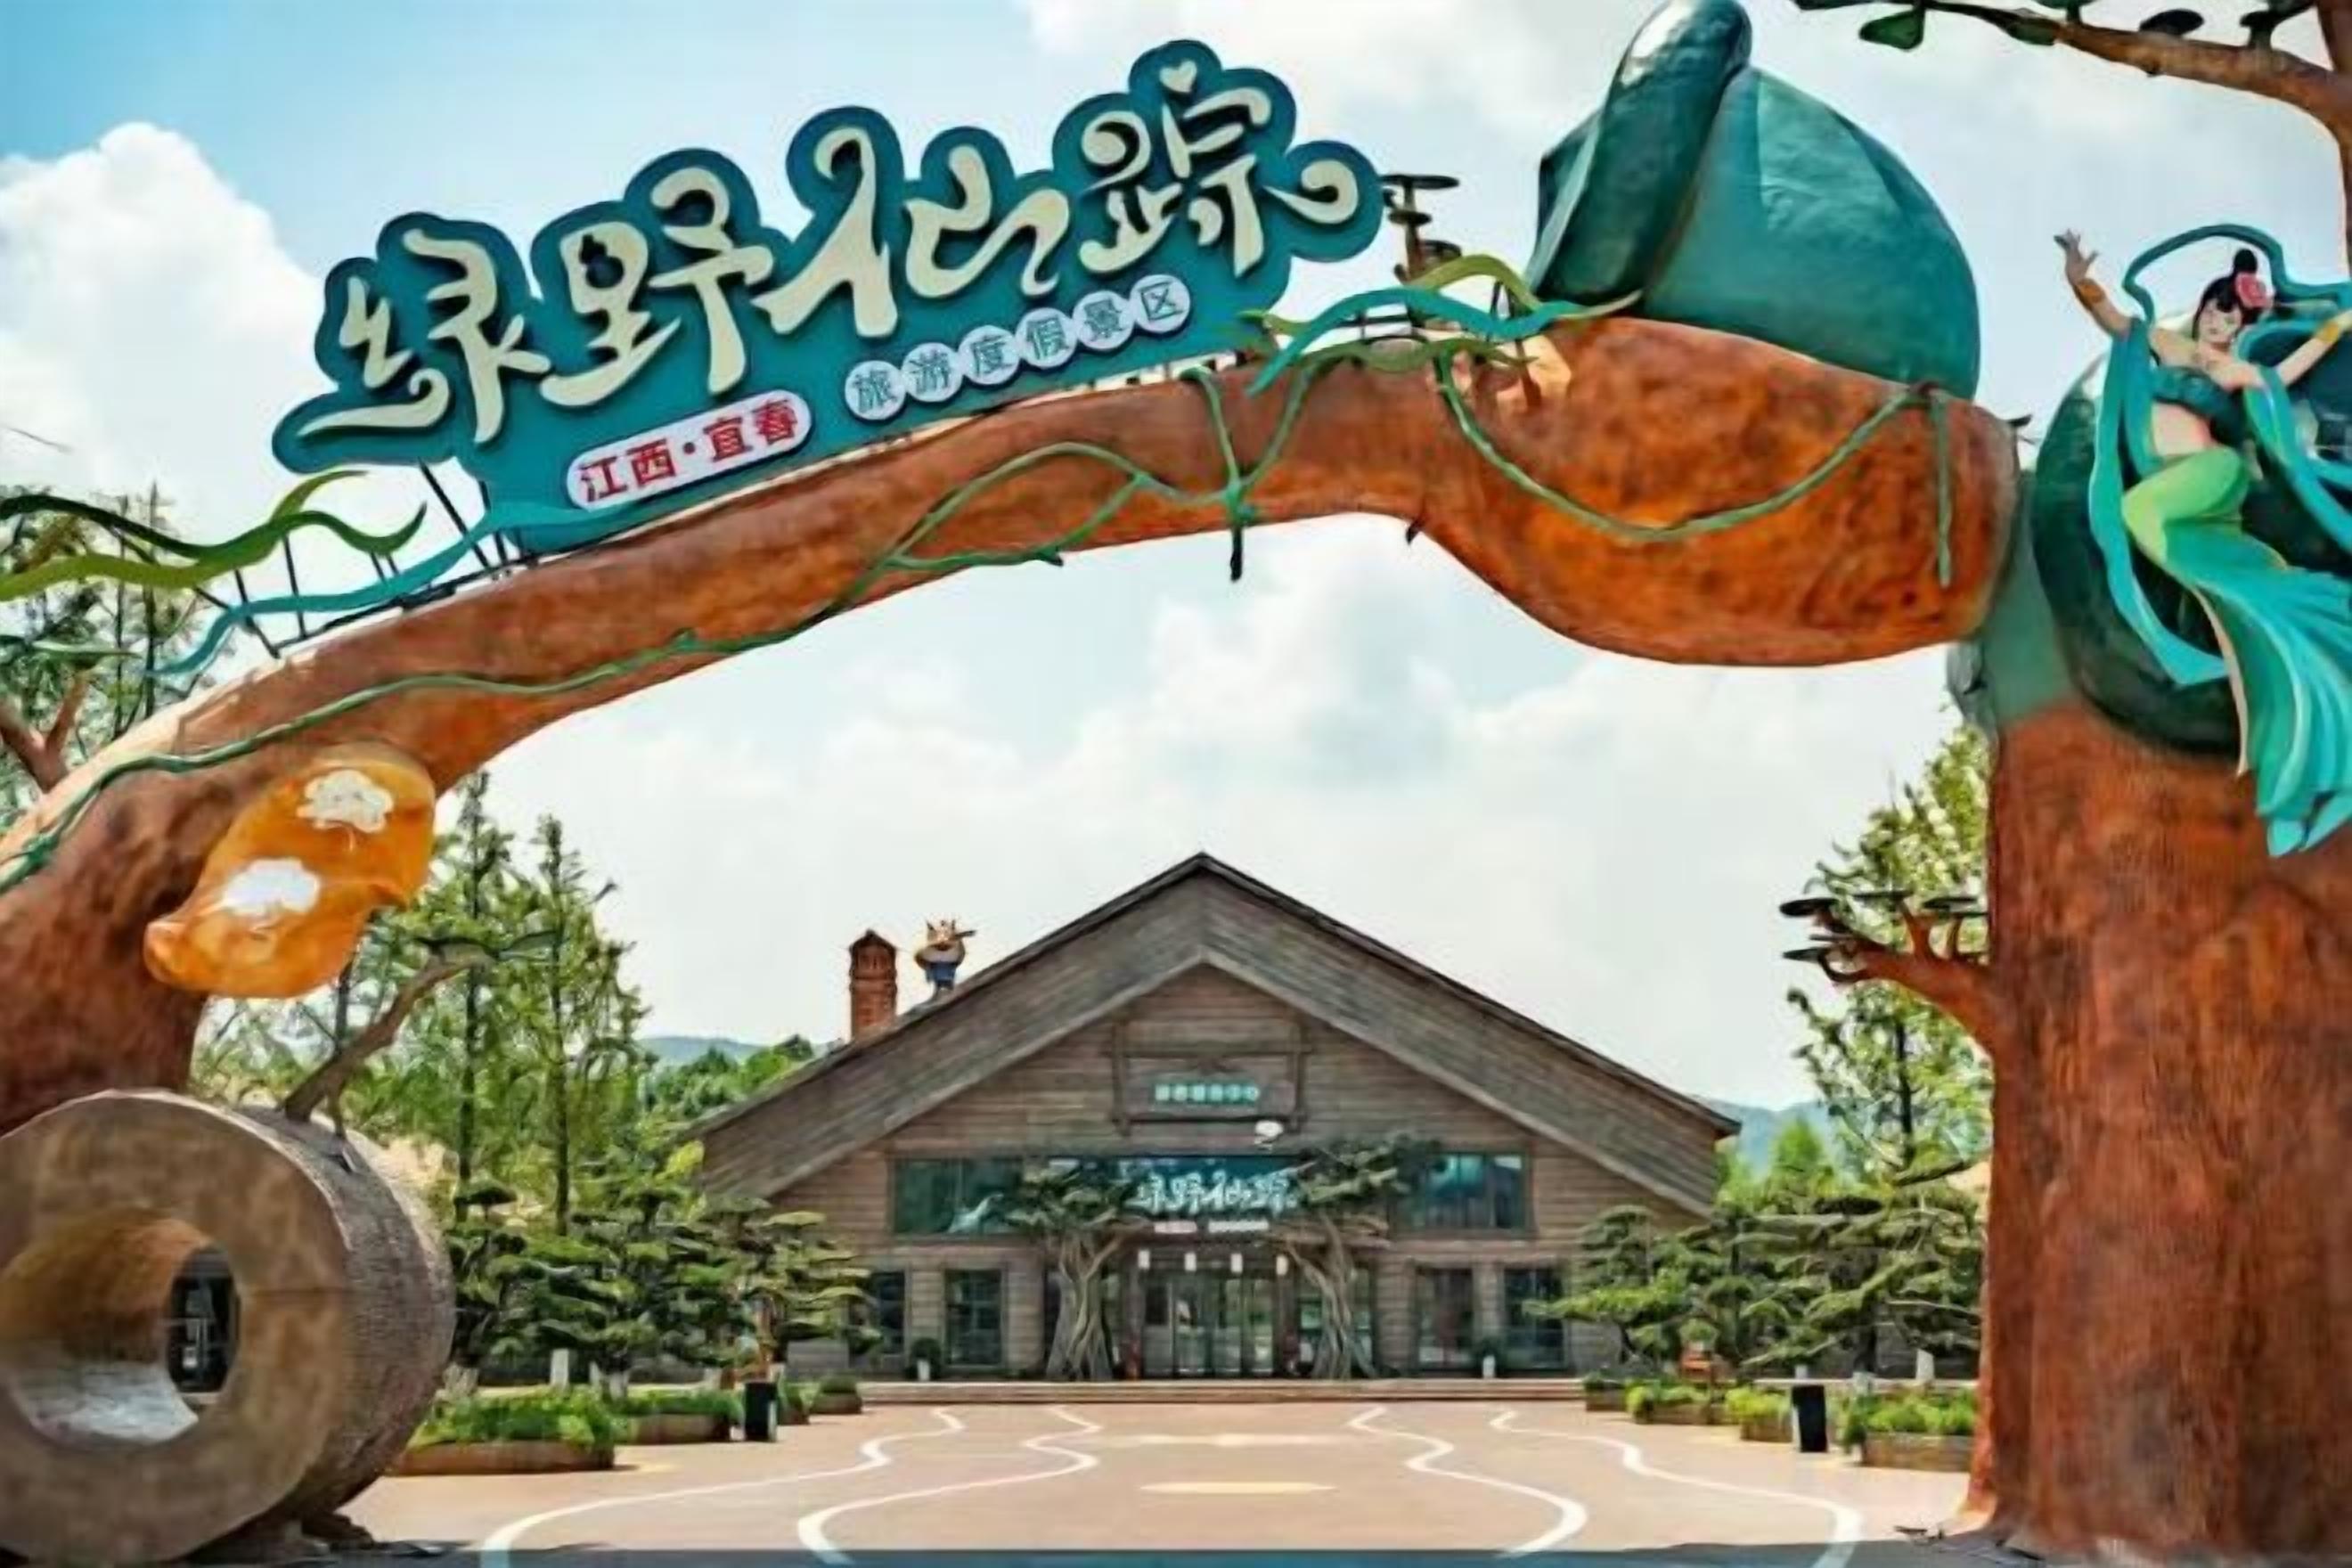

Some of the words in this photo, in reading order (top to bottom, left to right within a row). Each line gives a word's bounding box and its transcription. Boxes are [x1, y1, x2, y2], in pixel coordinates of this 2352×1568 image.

[295, 59, 1360, 444] 绿野仙踪
[852, 280, 1184, 412] 旅游度假景区
[578, 397, 799, 502] 江西·宜春
